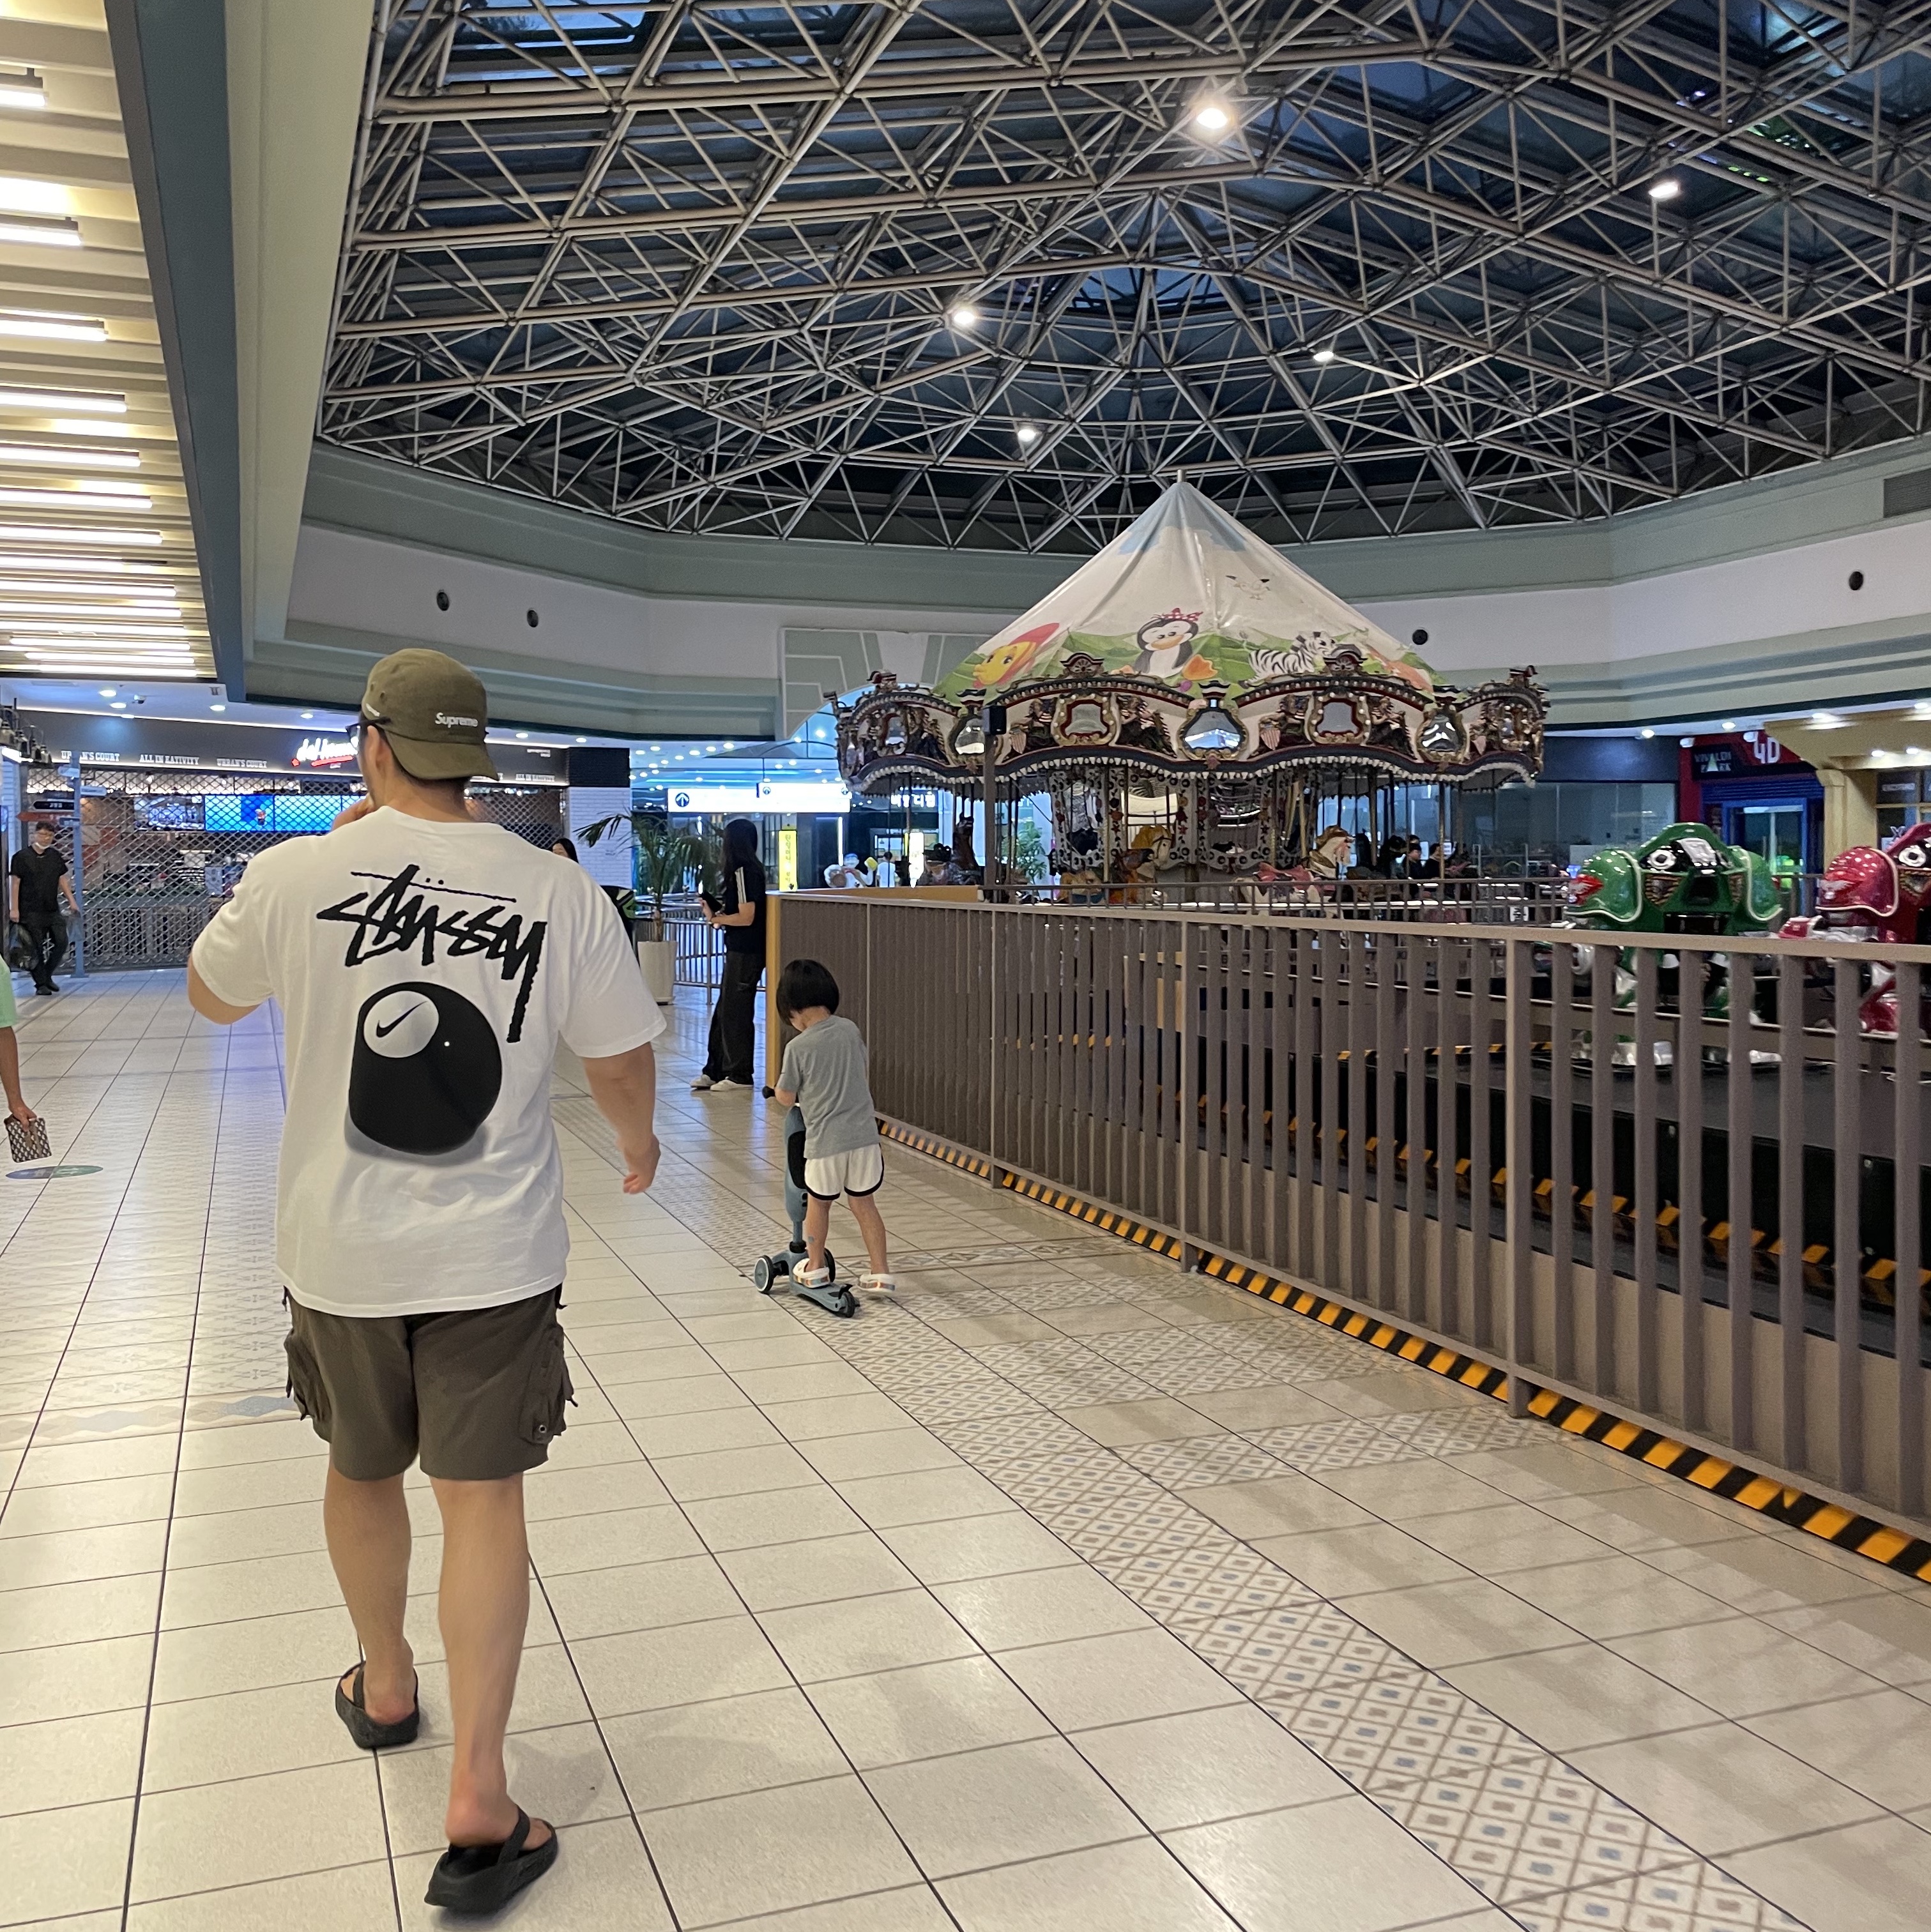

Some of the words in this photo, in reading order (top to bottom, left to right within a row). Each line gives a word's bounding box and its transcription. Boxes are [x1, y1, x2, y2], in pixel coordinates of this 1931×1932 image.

[435, 712, 478, 728] Supreme
[1753, 732, 1780, 764] 4D
[95, 752, 120, 762] COURT
[139, 754, 155, 763] ALL
[155, 755, 164, 764] IN
